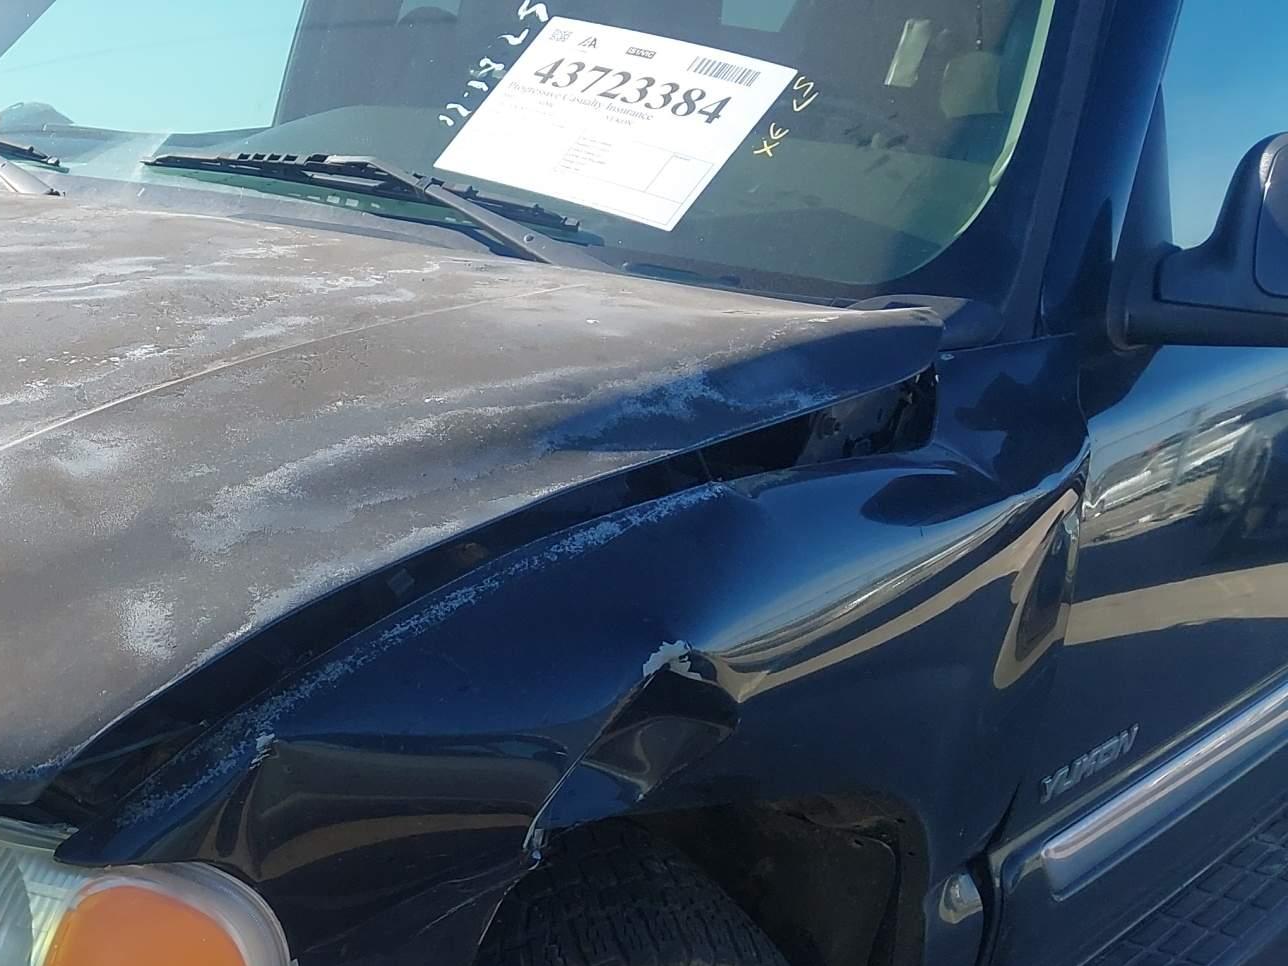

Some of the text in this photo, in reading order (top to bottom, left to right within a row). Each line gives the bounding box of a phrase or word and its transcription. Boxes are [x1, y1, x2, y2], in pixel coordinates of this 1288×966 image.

[533, 57, 733, 125] 43723384
[606, 102, 655, 121] Insurance
[1040, 722, 1140, 804] YUKON
